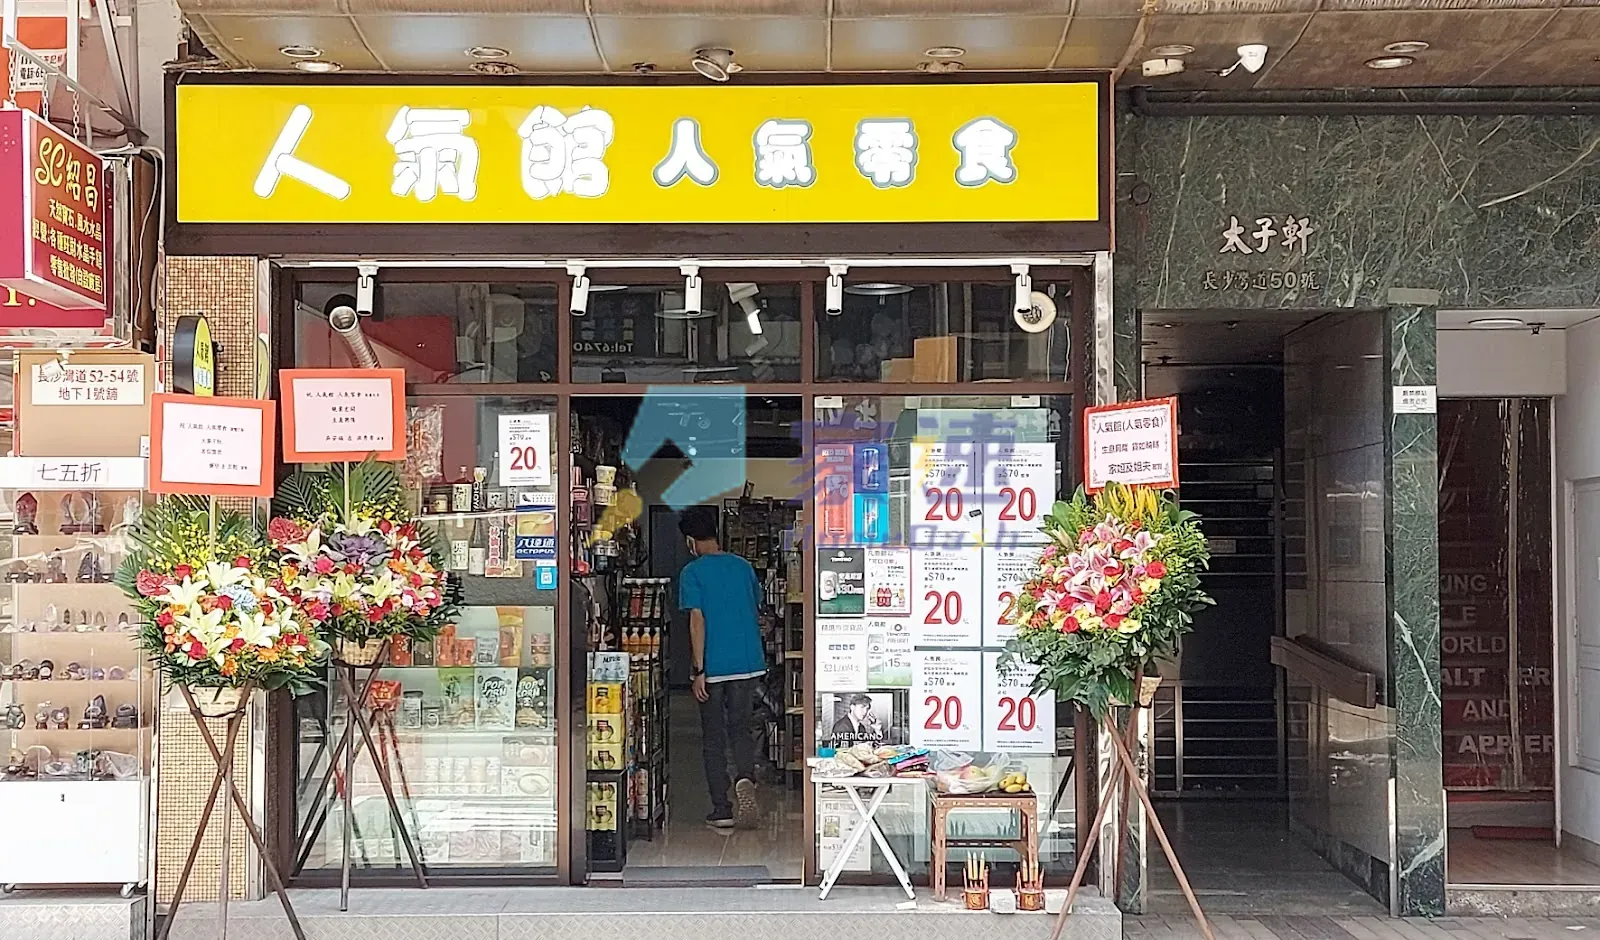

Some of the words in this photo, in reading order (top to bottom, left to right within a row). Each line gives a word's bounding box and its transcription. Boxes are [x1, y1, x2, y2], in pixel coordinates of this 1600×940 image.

[254, 104, 614, 202] 人氣館
[653, 116, 1020, 190] 人氣零食
[1219, 214, 1315, 256] 太子軒
[37, 462, 102, 482] 七五折
[517, 538, 555, 549] 八達通
[831, 732, 884, 741] AMERICANO
